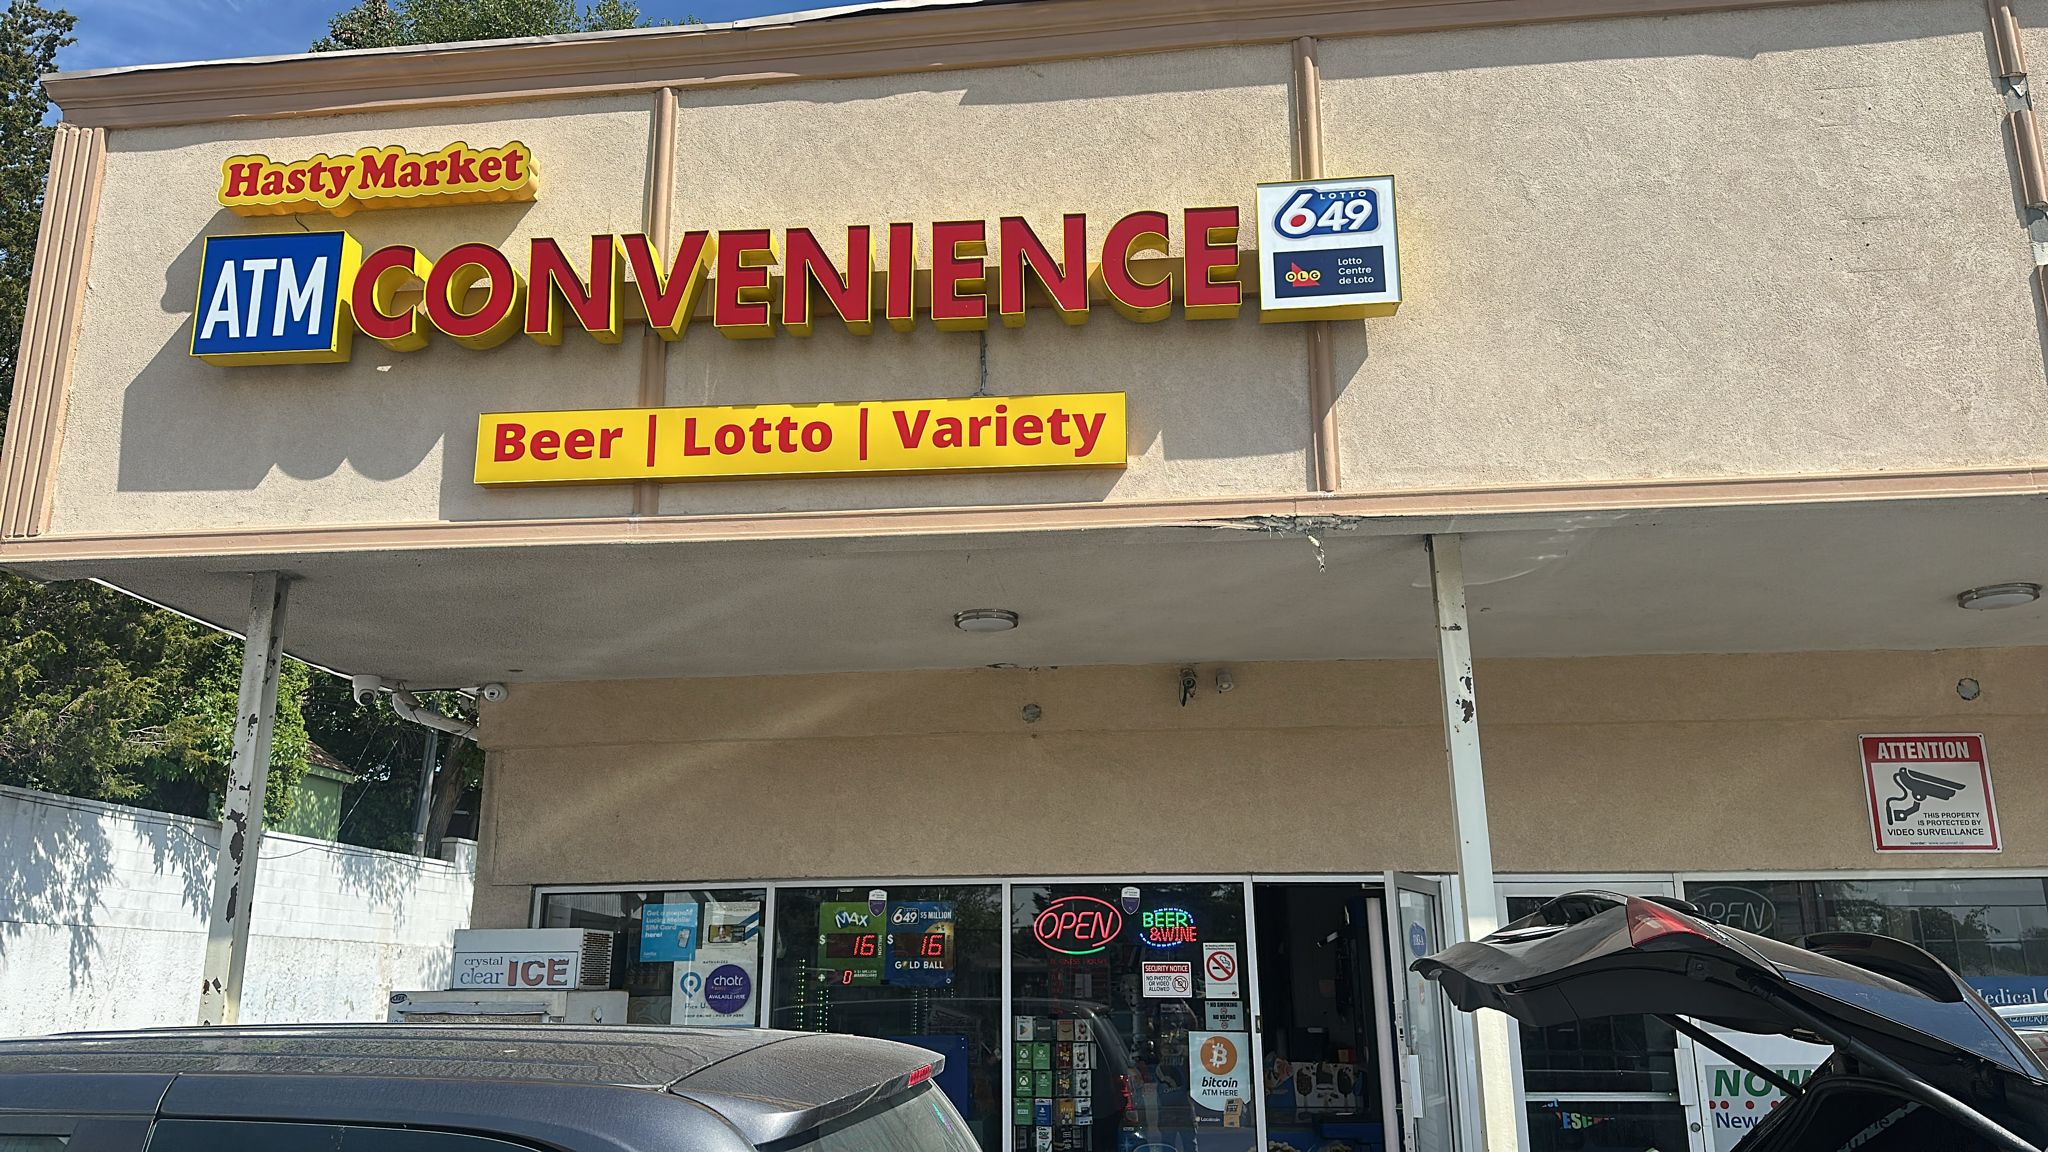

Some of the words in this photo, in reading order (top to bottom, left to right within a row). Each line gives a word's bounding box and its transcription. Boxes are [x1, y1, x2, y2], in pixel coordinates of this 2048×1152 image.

[224, 162, 355, 199] Hasty
[358, 149, 525, 190] Market
[1320, 190, 1367, 200] LOTTO
[1280, 193, 1373, 235] 649
[1338, 257, 1362, 266] Lotto
[350, 205, 1242, 341] CONVENIENCE
[1285, 270, 1321, 282] OLG
[1338, 266, 1372, 275] Centre
[1339, 277, 1352, 285] de
[1353, 275, 1375, 284] Loto
[199, 256, 328, 340] ATM
[494, 422, 624, 463] Beer
[684, 415, 833, 457] Lotto
[892, 404, 1107, 458] Variety
[1877, 741, 1970, 760] ATTENTION
[1887, 828, 1915, 836] VIDEO
[1916, 828, 1985, 836] SURVEILLANCE
[893, 908, 918, 923] 649
[928, 911, 952, 919] MILLION
[1142, 912, 1188, 928] BEER
[1038, 911, 1114, 939] OPEN
[853, 934, 875, 956] 16
[920, 934, 943, 956] 16
[464, 957, 503, 969] crystal
[508, 956, 570, 987] ICE
[923, 961, 944, 969] BALL
[460, 967, 504, 985] clear
[713, 975, 743, 986] chatr
[1202, 1076, 1238, 1088] bitcoin
[1715, 1112, 1759, 1129] New
